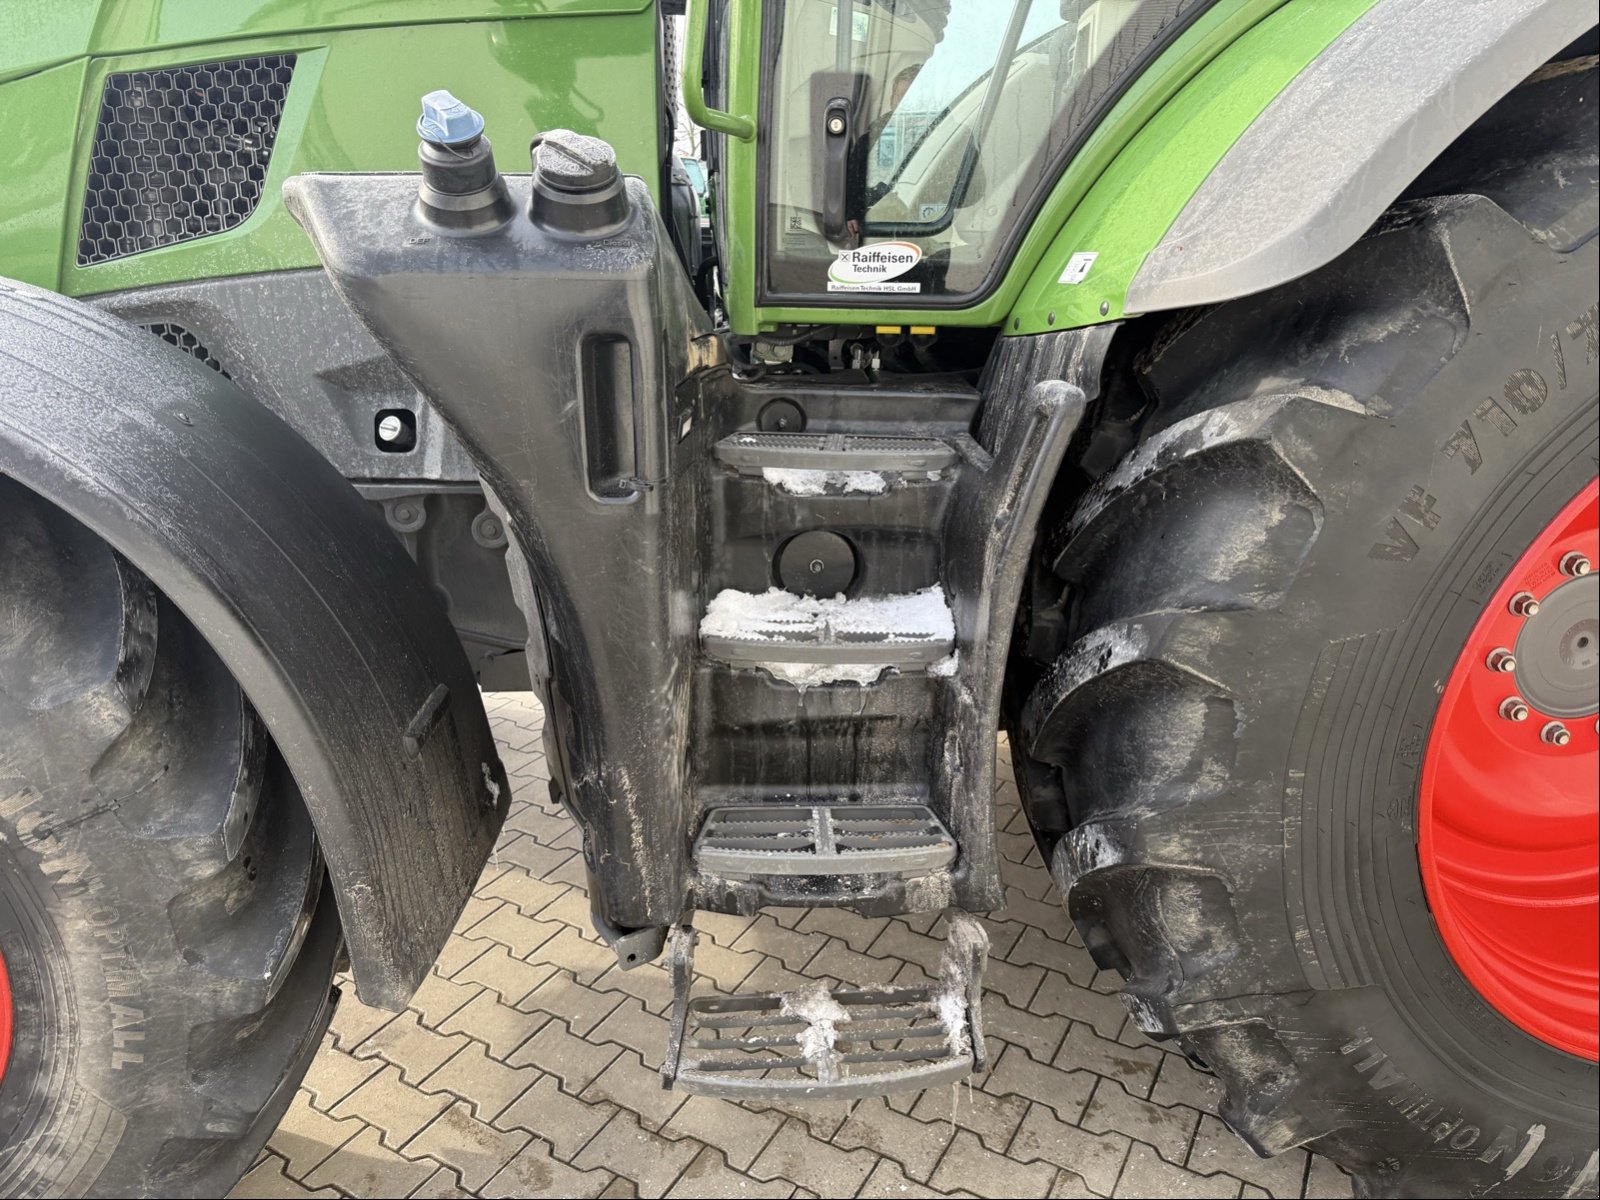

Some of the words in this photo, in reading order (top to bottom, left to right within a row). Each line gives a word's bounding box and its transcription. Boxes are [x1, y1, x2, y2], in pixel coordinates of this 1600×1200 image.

[852, 251, 913, 263] Raiffeisen
[852, 264, 887, 273] Technik
[1367, 484, 1441, 561] VF
